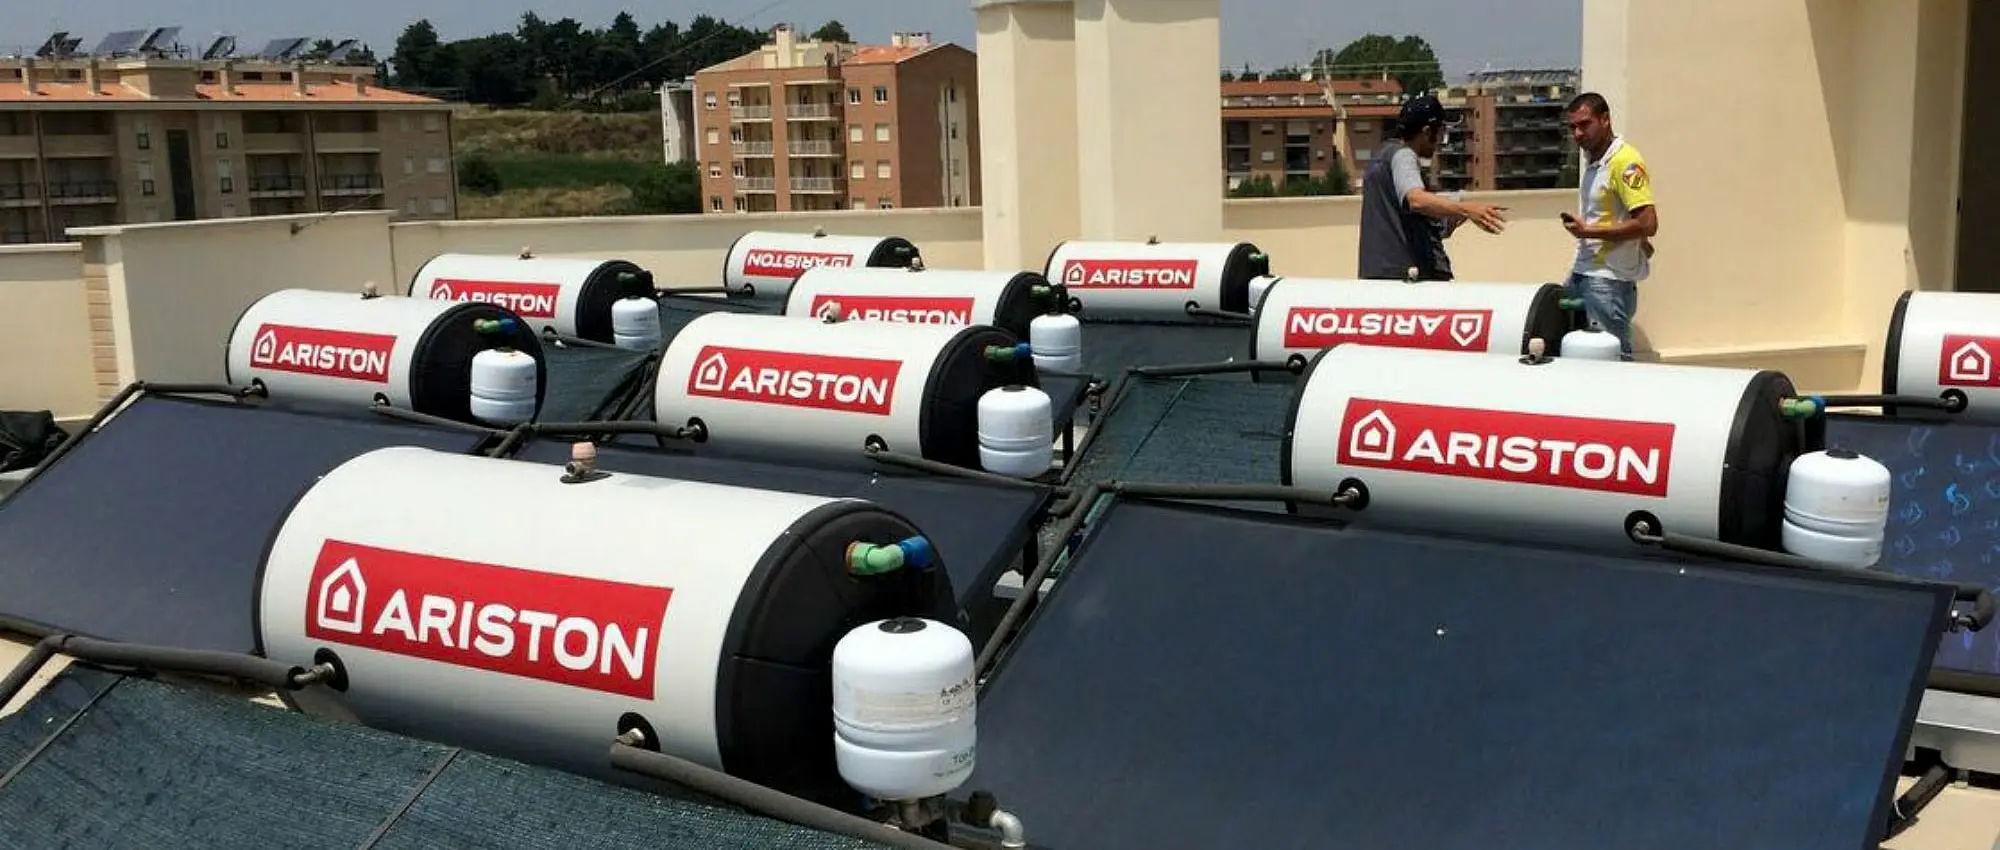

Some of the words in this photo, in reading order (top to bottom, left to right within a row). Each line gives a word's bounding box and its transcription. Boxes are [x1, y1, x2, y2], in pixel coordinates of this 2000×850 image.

[748, 253, 828, 269] ARISTON
[1088, 269, 1191, 285] ARISTON
[1291, 312, 1446, 335] ARISTON
[278, 342, 387, 375] ARISTON
[729, 367, 888, 406] ARISTON
[1403, 429, 1659, 484] ARISTON
[373, 588, 648, 681] ARISTON
